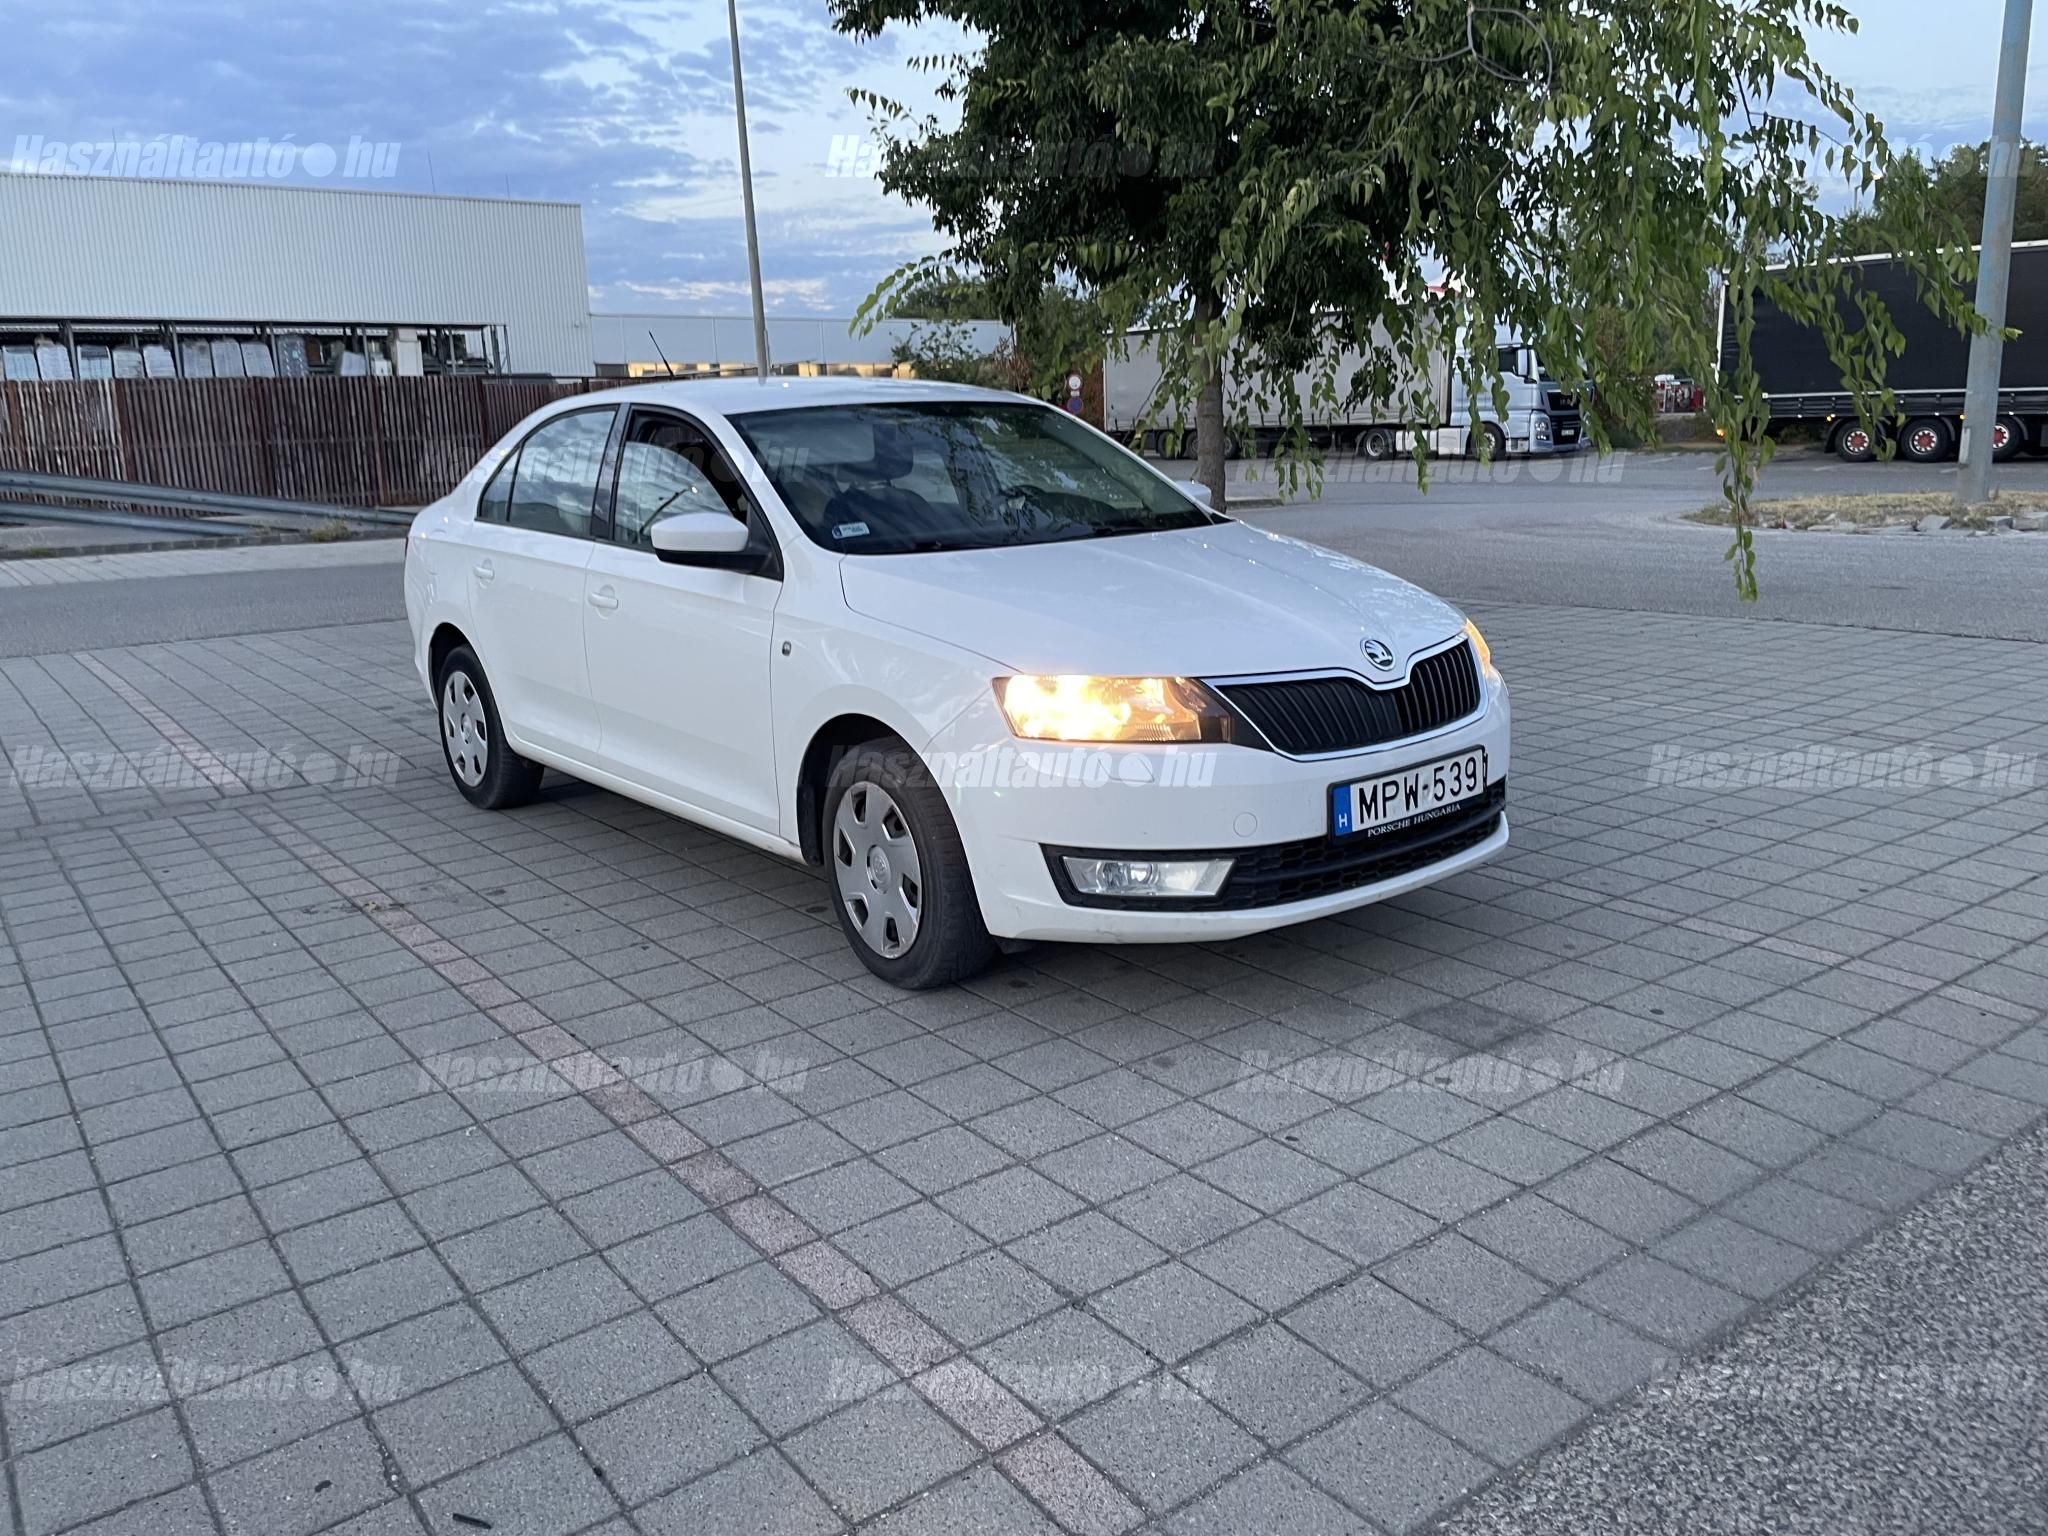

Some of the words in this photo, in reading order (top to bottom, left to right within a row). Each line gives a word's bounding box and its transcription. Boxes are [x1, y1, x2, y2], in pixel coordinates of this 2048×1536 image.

[1358, 757, 1477, 825] MPW-539
[1338, 813, 1348, 829] H
[1367, 818, 1411, 838] PORSCHE
[1413, 802, 1462, 824] HUNGARIA
